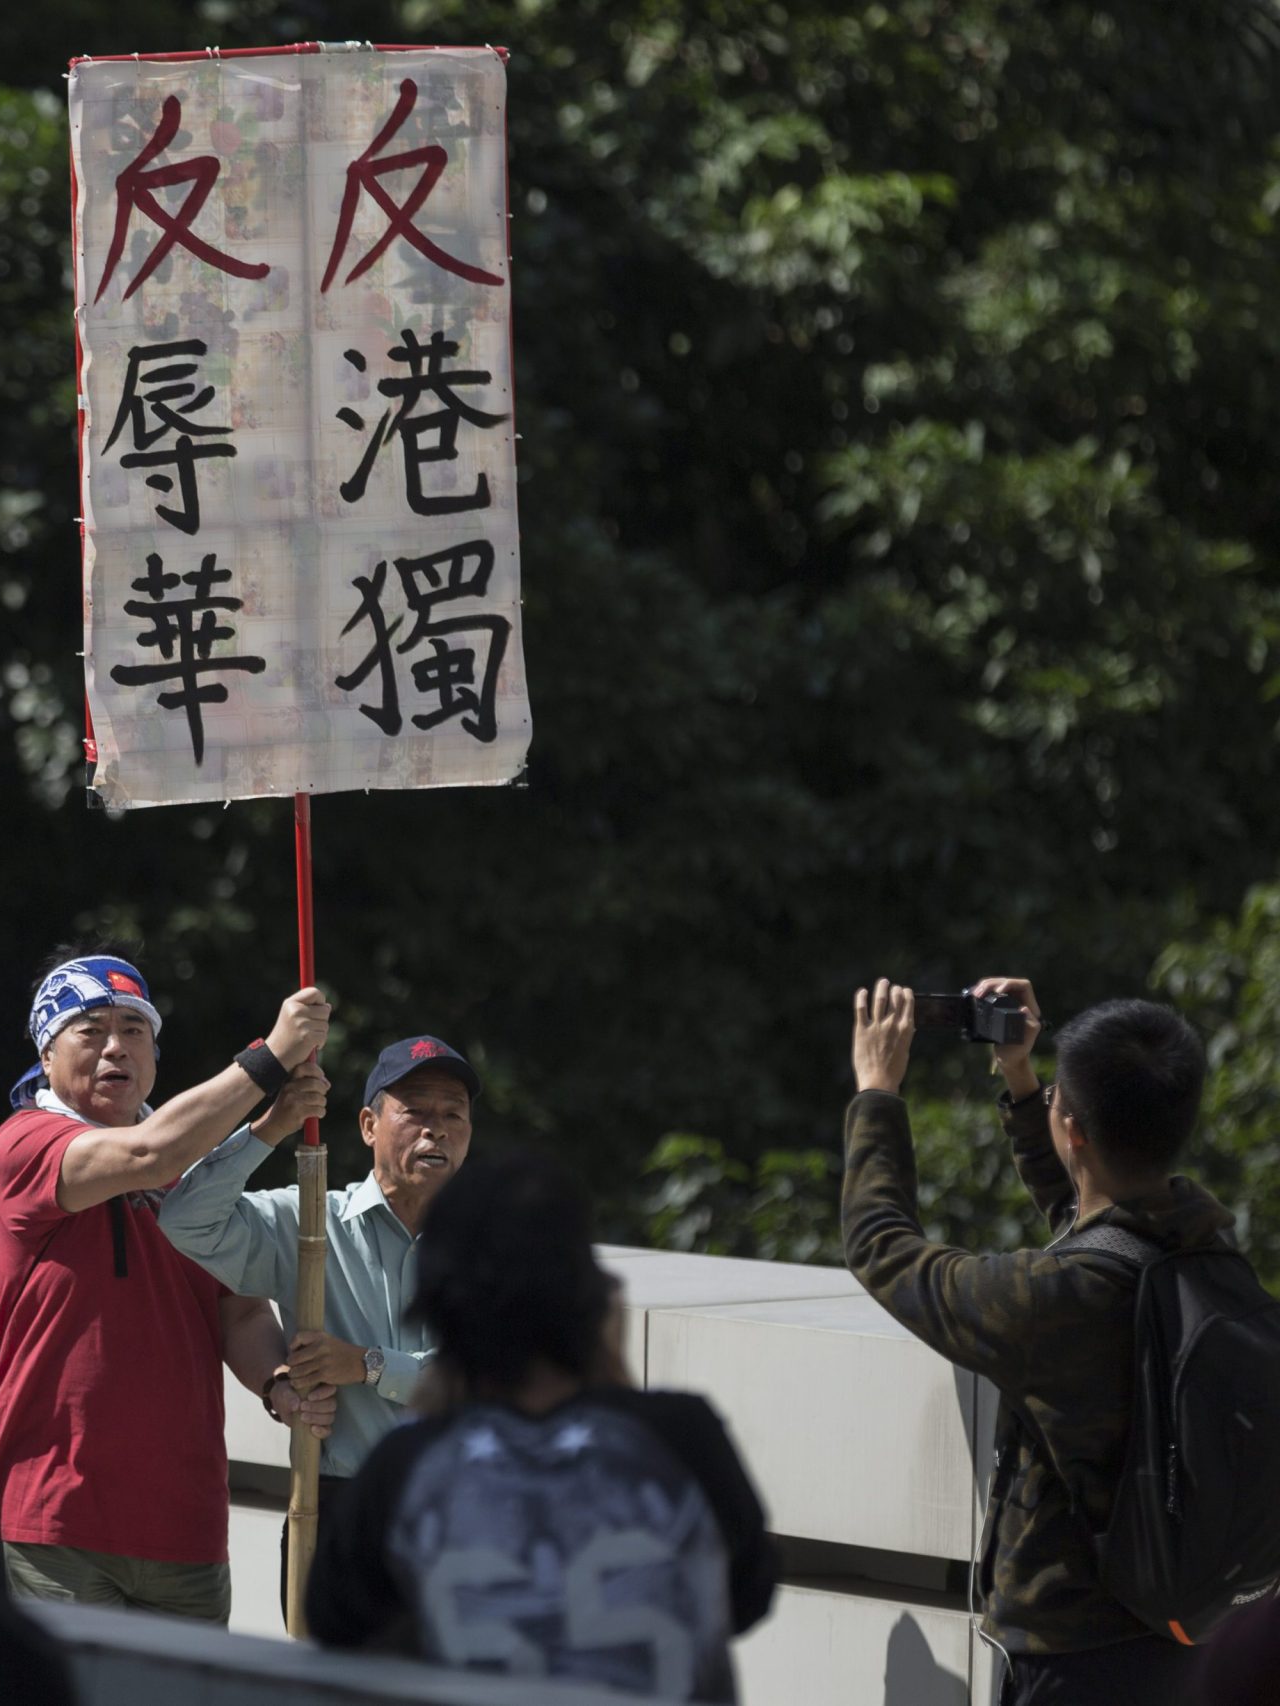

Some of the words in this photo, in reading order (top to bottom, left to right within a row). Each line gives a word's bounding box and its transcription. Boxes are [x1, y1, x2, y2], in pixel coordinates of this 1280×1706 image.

[90, 94, 272, 768] 反辱華
[321, 77, 513, 743] 反港獨
